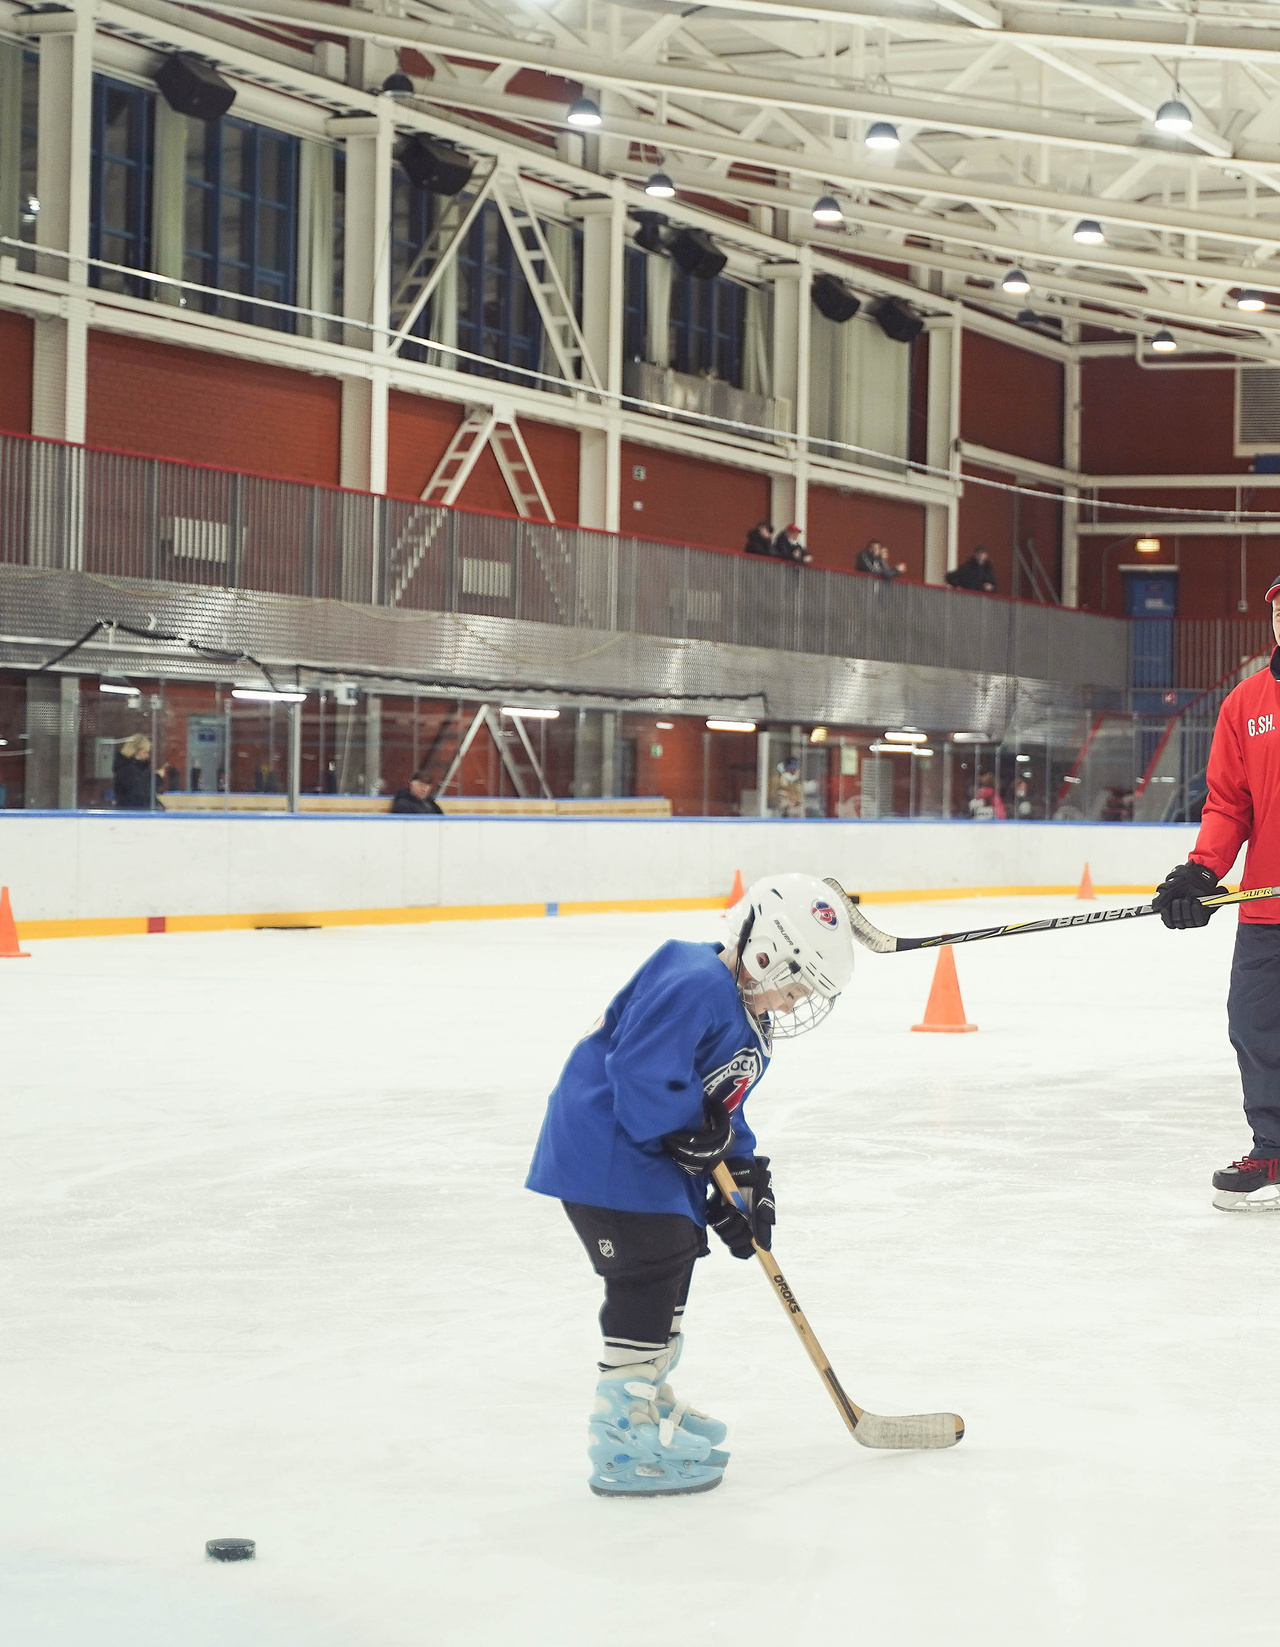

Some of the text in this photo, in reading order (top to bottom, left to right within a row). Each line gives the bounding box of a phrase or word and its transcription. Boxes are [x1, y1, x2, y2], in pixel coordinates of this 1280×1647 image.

[1247, 713, 1276, 737] G.SH.
[1241, 889, 1271, 898] SUPR
[773, 1274, 801, 1314] OROKS
